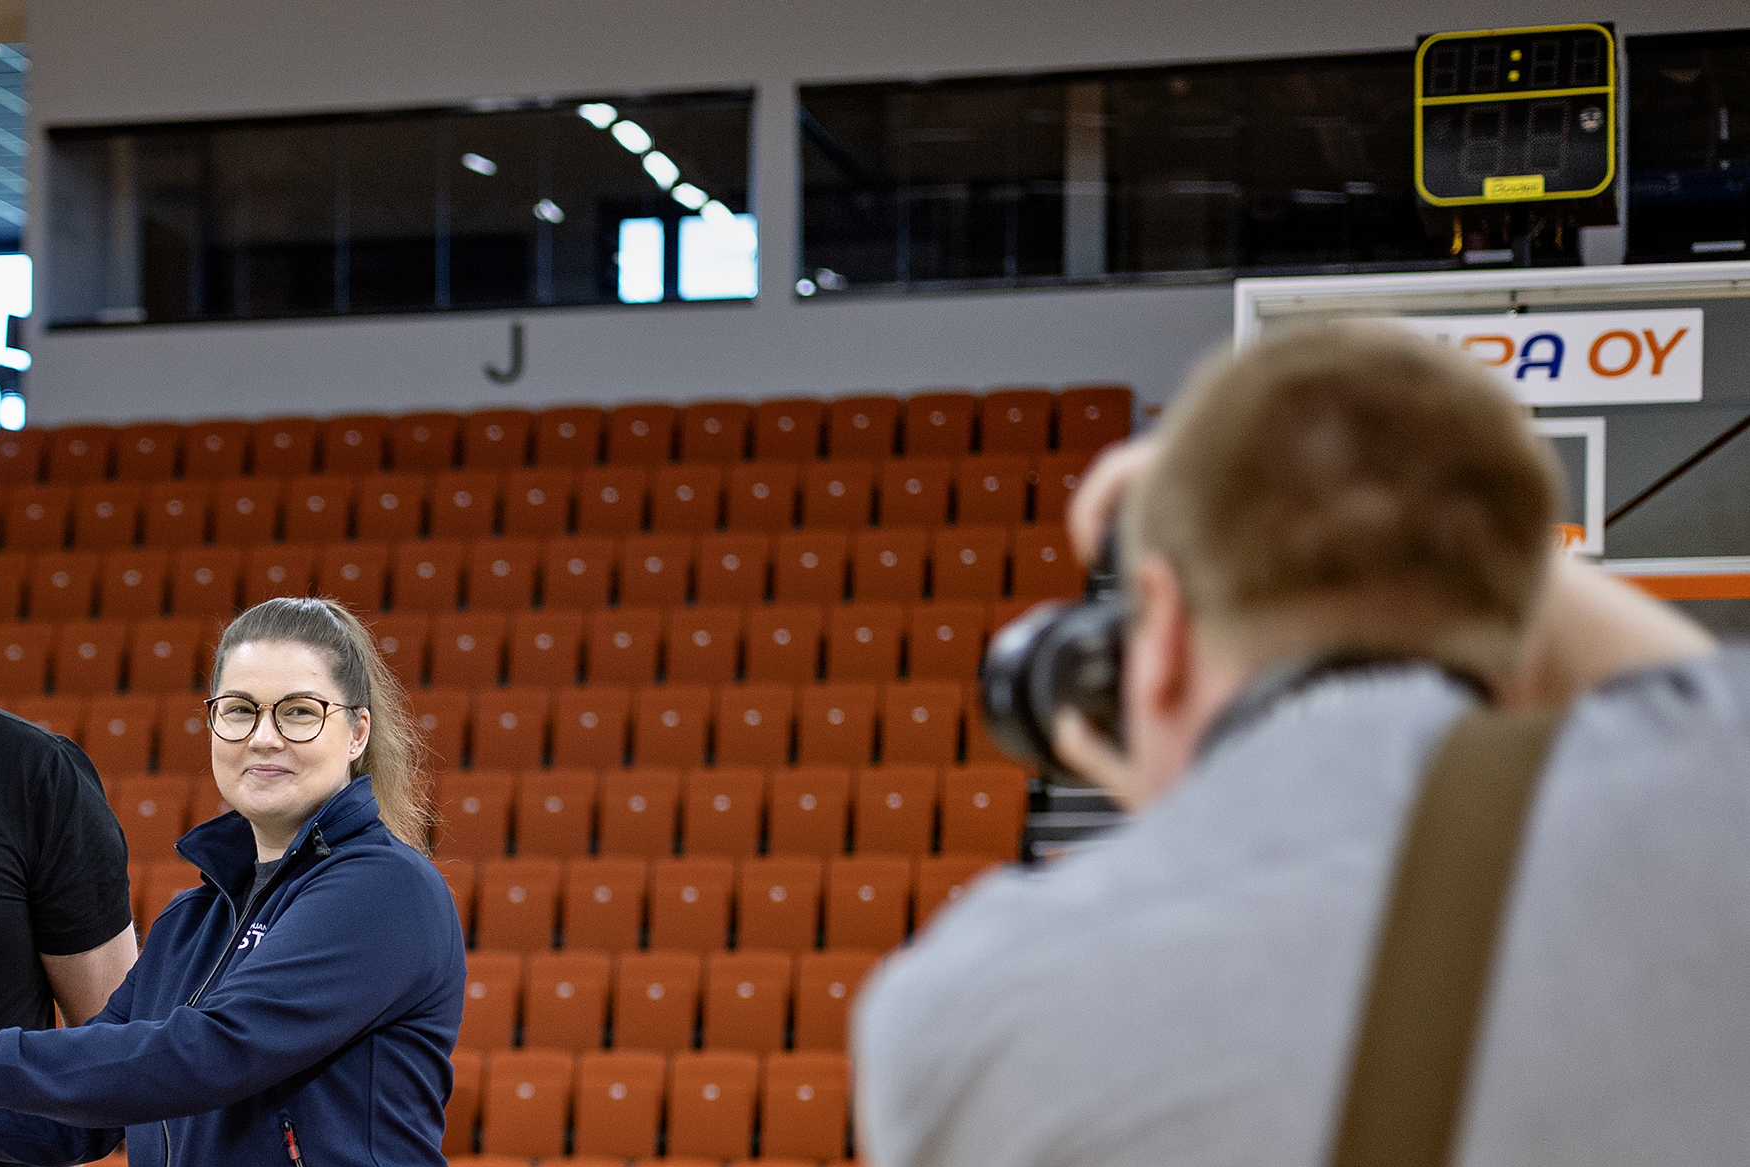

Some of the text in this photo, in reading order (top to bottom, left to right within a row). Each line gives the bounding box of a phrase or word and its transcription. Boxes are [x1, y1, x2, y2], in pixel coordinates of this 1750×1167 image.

[485, 322, 524, 384] J
[1460, 328, 1690, 380] PA OY
